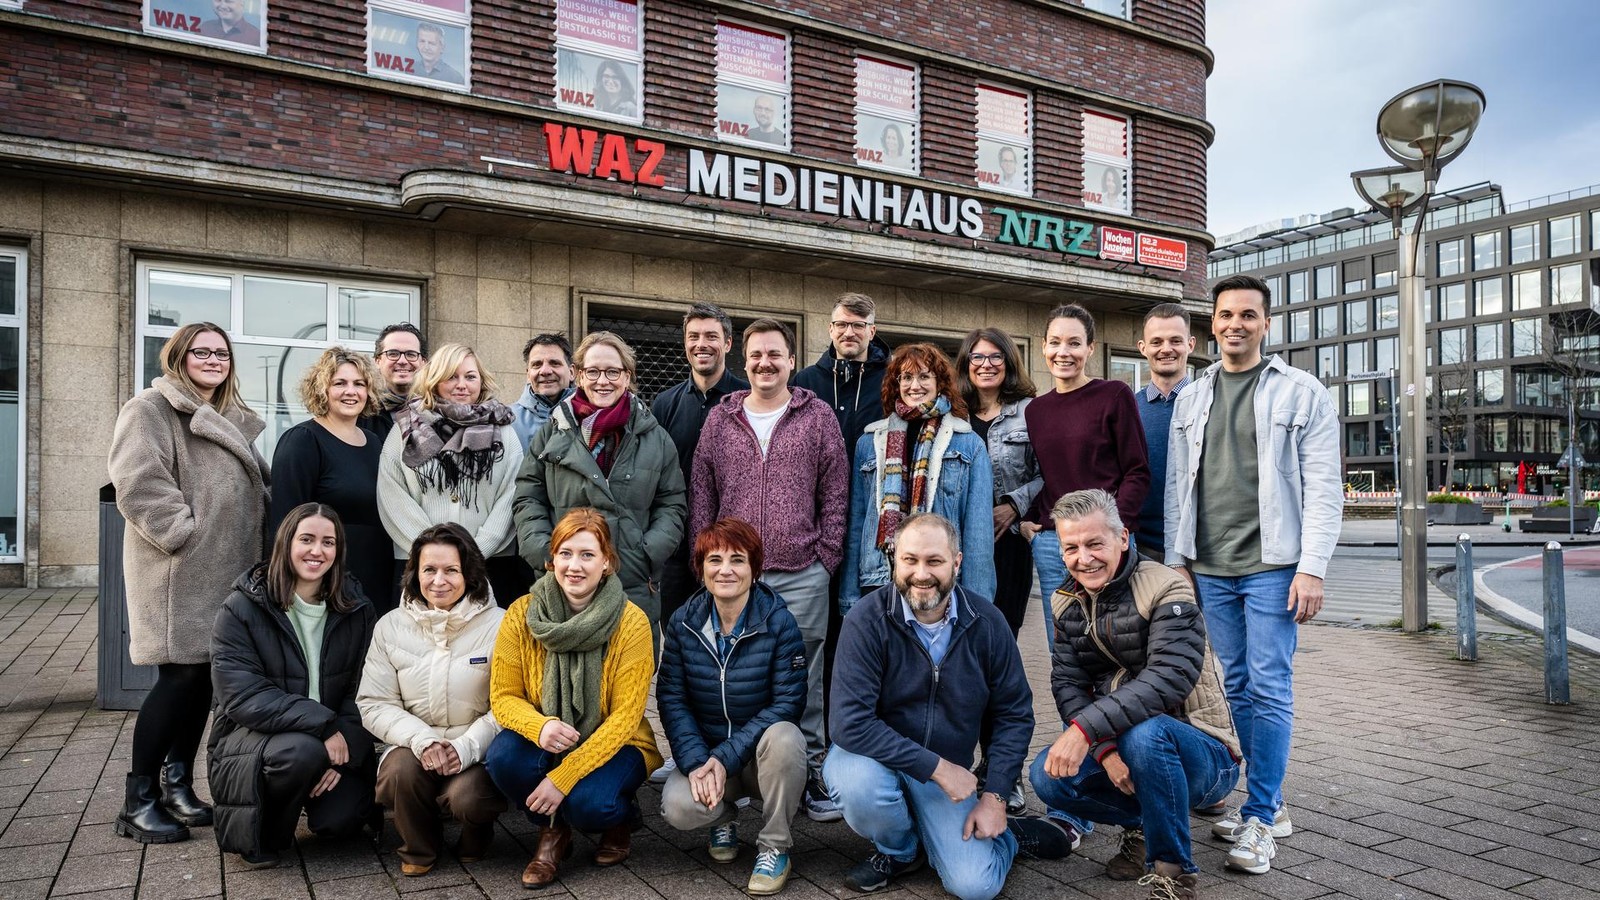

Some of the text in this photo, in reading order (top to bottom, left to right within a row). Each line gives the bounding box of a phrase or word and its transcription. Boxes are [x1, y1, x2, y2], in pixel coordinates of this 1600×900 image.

[153, 9, 201, 33] WAZ
[560, 10, 637, 35] DUISBURG FÜR MICH
[609, 11, 630, 23] WEIL
[560, 21, 633, 45] ERSTKLASSIG IST.
[719, 42, 771, 61] DIE STADT IHRE
[759, 43, 776, 53] WEIL
[374, 51, 416, 73] WAZ
[719, 51, 784, 72] POTENZIALE NICHT
[560, 88, 595, 108] WAZ
[719, 119, 749, 137] WAZ
[857, 148, 883, 164] WAZ
[977, 170, 1000, 185] WAZ
[543, 122, 1100, 258] WAZ MEDIENHAUS NRZ
[1105, 231, 1132, 245] Wochen
[1142, 237, 1158, 247] 92.2
[1104, 240, 1133, 256] Anzeiger
